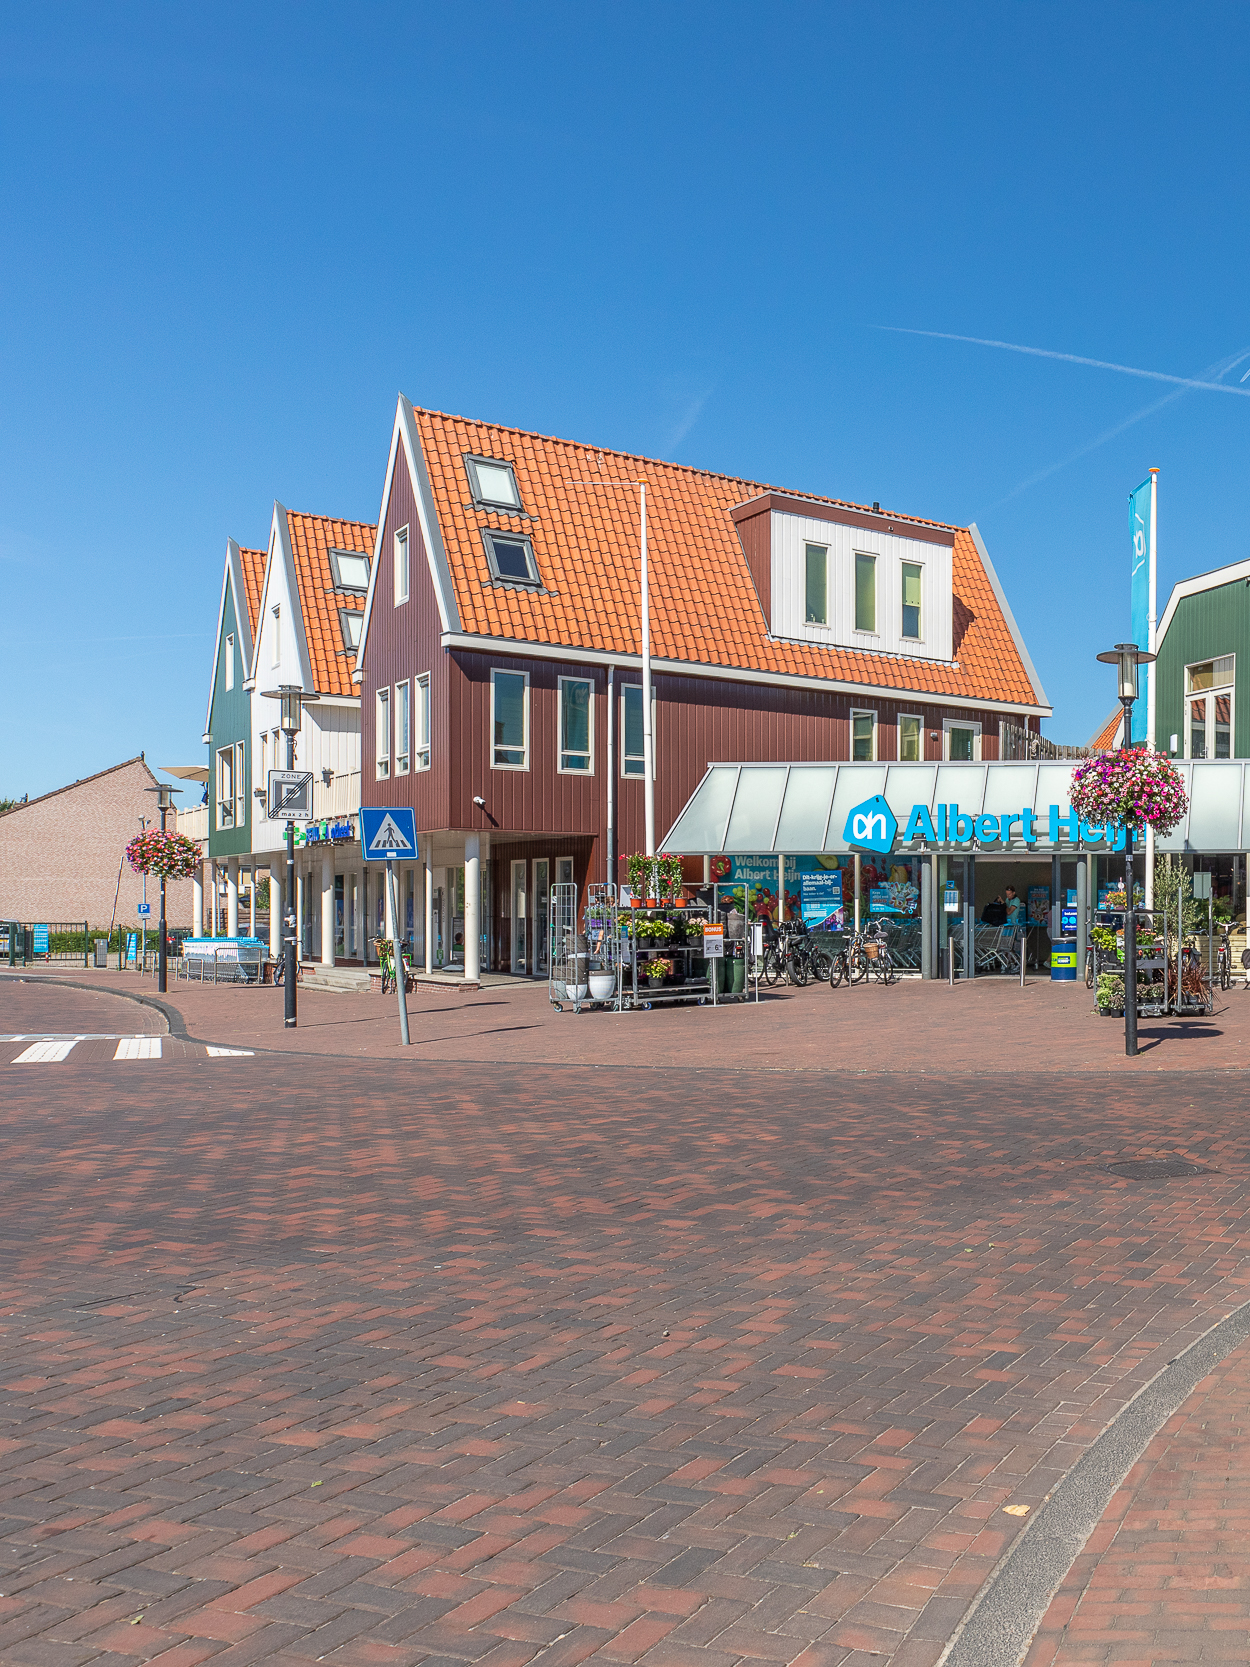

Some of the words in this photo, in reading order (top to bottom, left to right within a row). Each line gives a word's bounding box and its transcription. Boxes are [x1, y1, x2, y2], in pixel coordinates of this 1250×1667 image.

[902, 803, 1038, 843] Albert
[734, 855, 780, 867] Welkom
[734, 868, 771, 880] Albert
